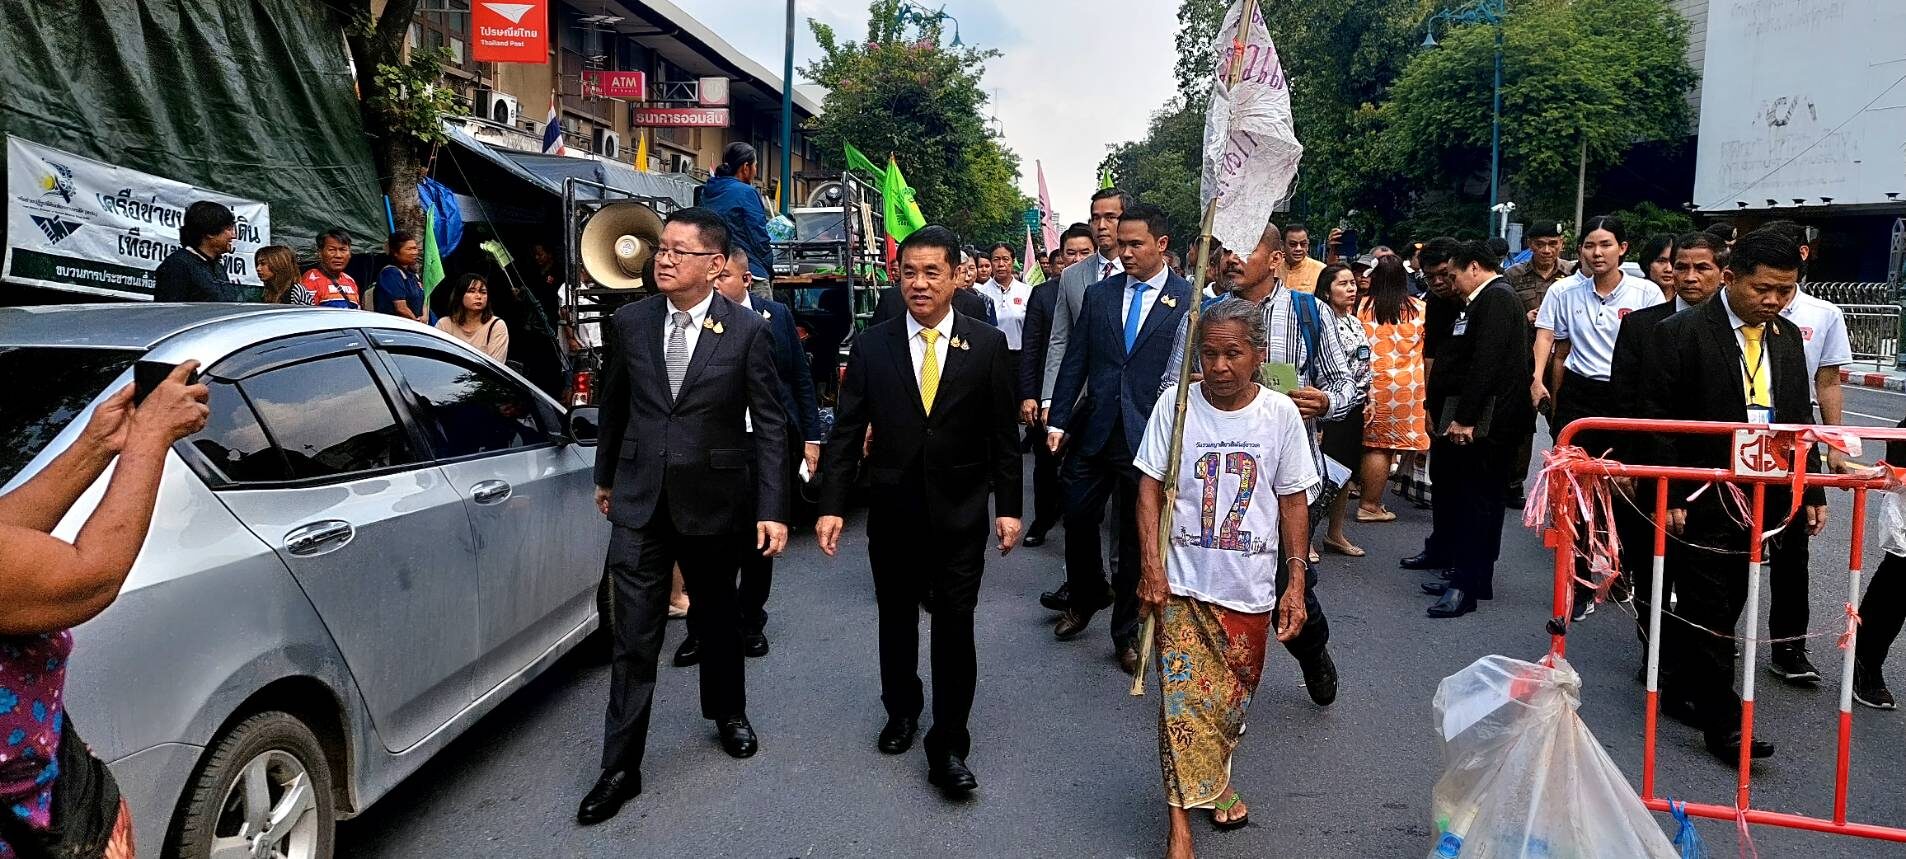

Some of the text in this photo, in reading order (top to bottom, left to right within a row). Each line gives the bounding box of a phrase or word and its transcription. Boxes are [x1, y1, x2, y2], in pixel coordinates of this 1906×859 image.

[480, 26, 538, 38] ไปรษณีย์ไทย
[480, 39, 509, 47] Thailand
[611, 76, 637, 88] ATM
[636, 111, 723, 125] ธนาคารออมสิน
[1195, 452, 1257, 550] 12
